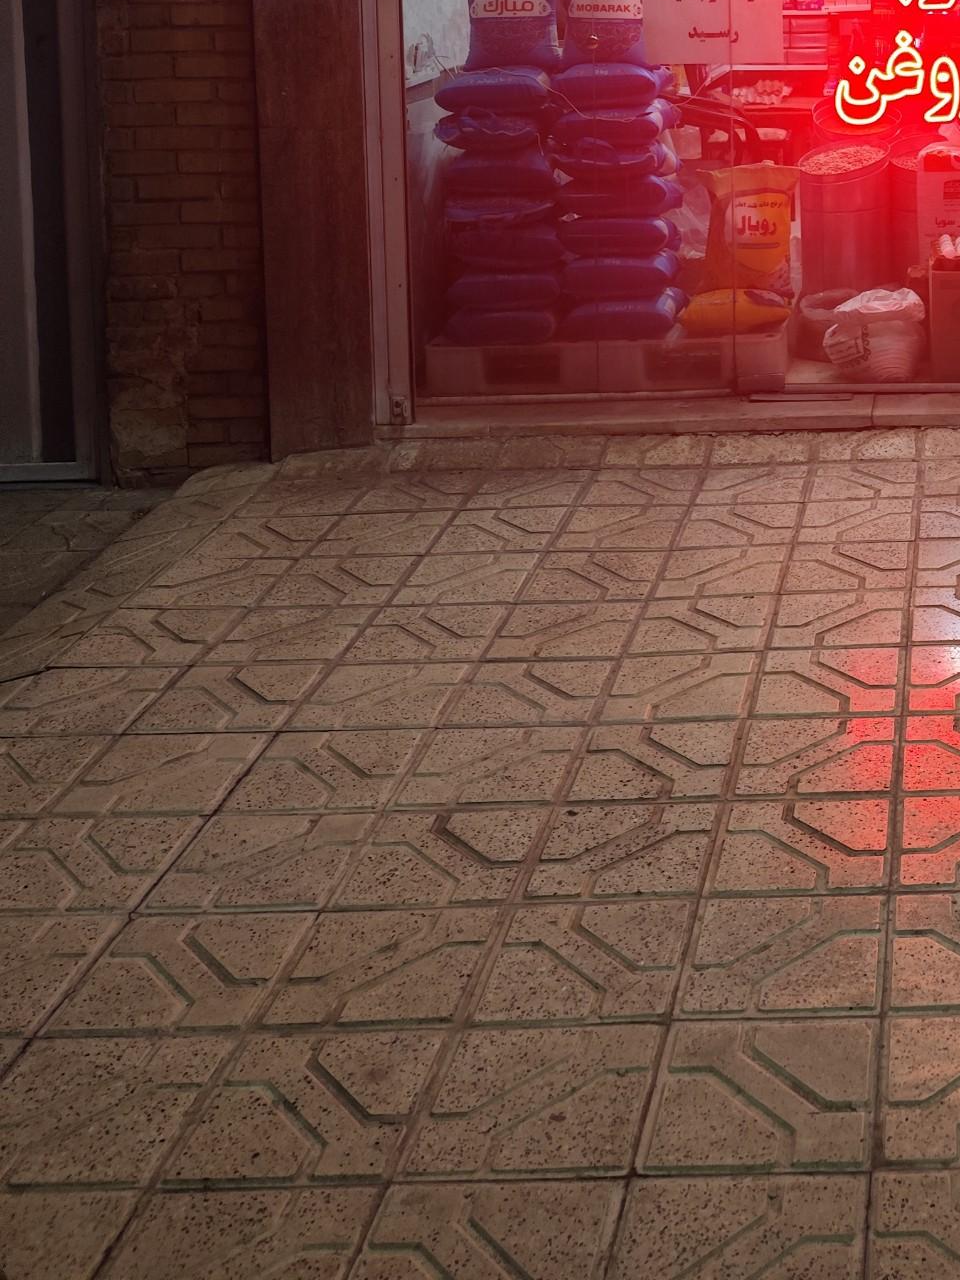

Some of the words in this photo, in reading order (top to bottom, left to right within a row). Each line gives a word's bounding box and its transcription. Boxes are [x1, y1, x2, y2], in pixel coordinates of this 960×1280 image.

[576, 3, 631, 13] MOBARAK
[688, 26, 739, 44] رسید
[736, 215, 777, 236] رویال
